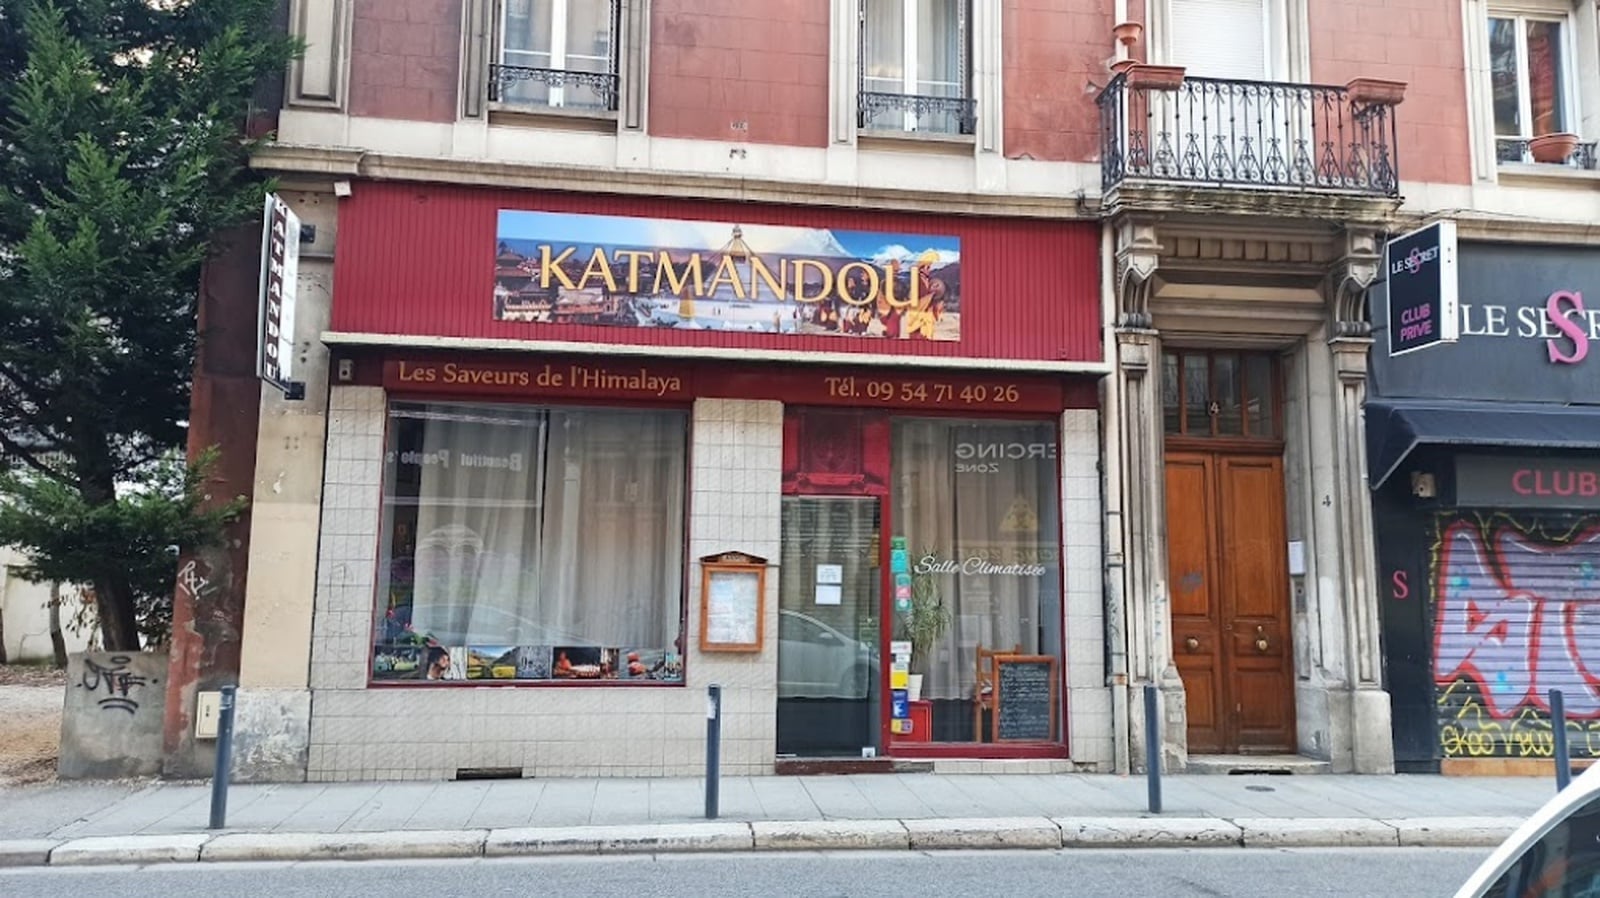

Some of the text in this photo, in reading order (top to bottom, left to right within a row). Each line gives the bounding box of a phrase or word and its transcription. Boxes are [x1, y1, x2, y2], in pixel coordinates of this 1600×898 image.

[536, 244, 923, 307] KATMANDOU
[1392, 260, 1403, 274] LE
[266, 198, 287, 378] KATMANDOU
[1401, 303, 1431, 325] CLUB
[1460, 303, 1509, 336] LE
[1400, 320, 1432, 341] PRIVE
[399, 361, 681, 396] Les Saveurs de l'Himalaya
[825, 376, 1019, 403] Tél. 09 54 71 40 26
[1210, 401, 1220, 415] 4
[1511, 469, 1598, 496] CLUB
[914, 555, 960, 575] Salle
[962, 557, 1047, 576] Climatisée
[1393, 570, 1409, 599] S
